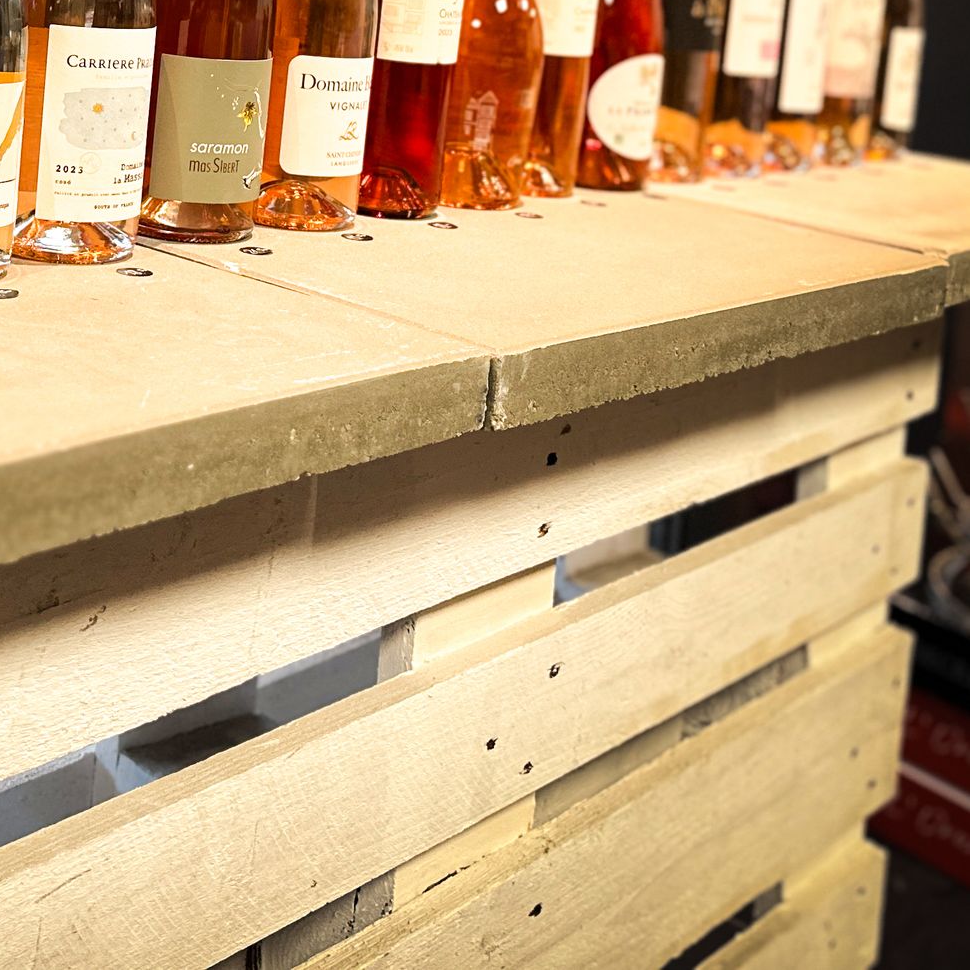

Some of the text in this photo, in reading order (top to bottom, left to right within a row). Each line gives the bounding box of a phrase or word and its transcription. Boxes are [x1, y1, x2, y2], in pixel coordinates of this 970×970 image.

[300, 73, 363, 92] Domaine
[190, 142, 249, 154] saramon
[56, 164, 83, 174] 2023
[189, 160, 211, 173] mas
[124, 172, 143, 183] Mass
